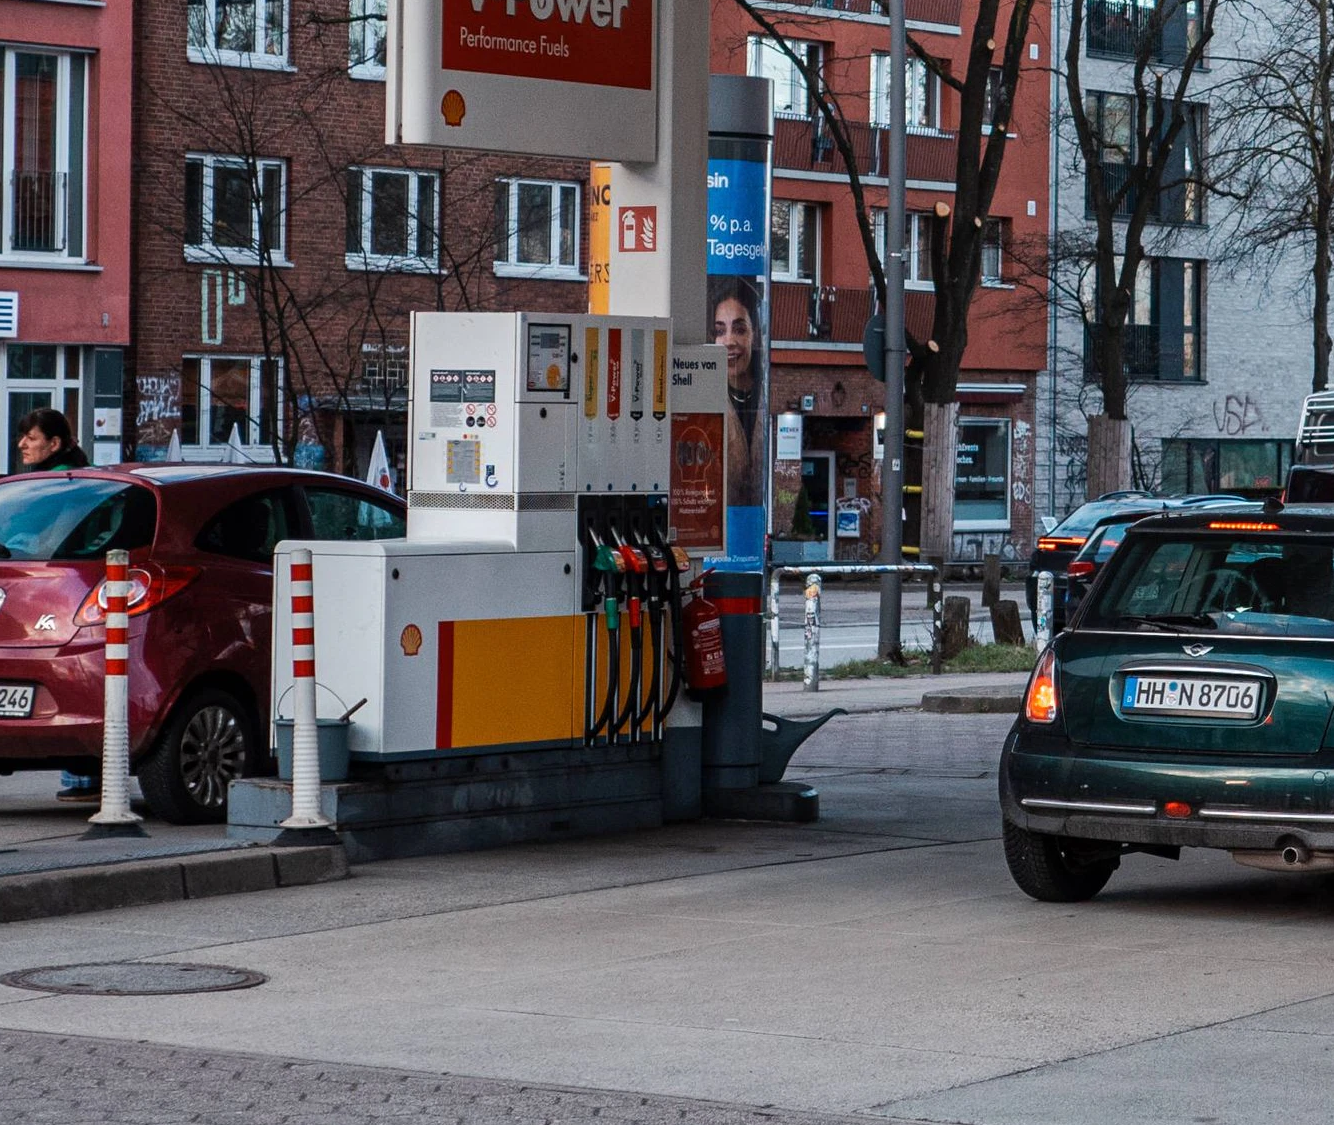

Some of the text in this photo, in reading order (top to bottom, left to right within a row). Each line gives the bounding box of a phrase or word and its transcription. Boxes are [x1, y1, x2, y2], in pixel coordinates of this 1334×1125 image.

[460, 26, 570, 58] Performance Fuels
[672, 358, 717, 371] Neues von
[672, 373, 693, 386] Shell
[1136, 681, 1166, 705] HH
[1179, 683, 1194, 706] N
[1198, 683, 1254, 709] 8706
